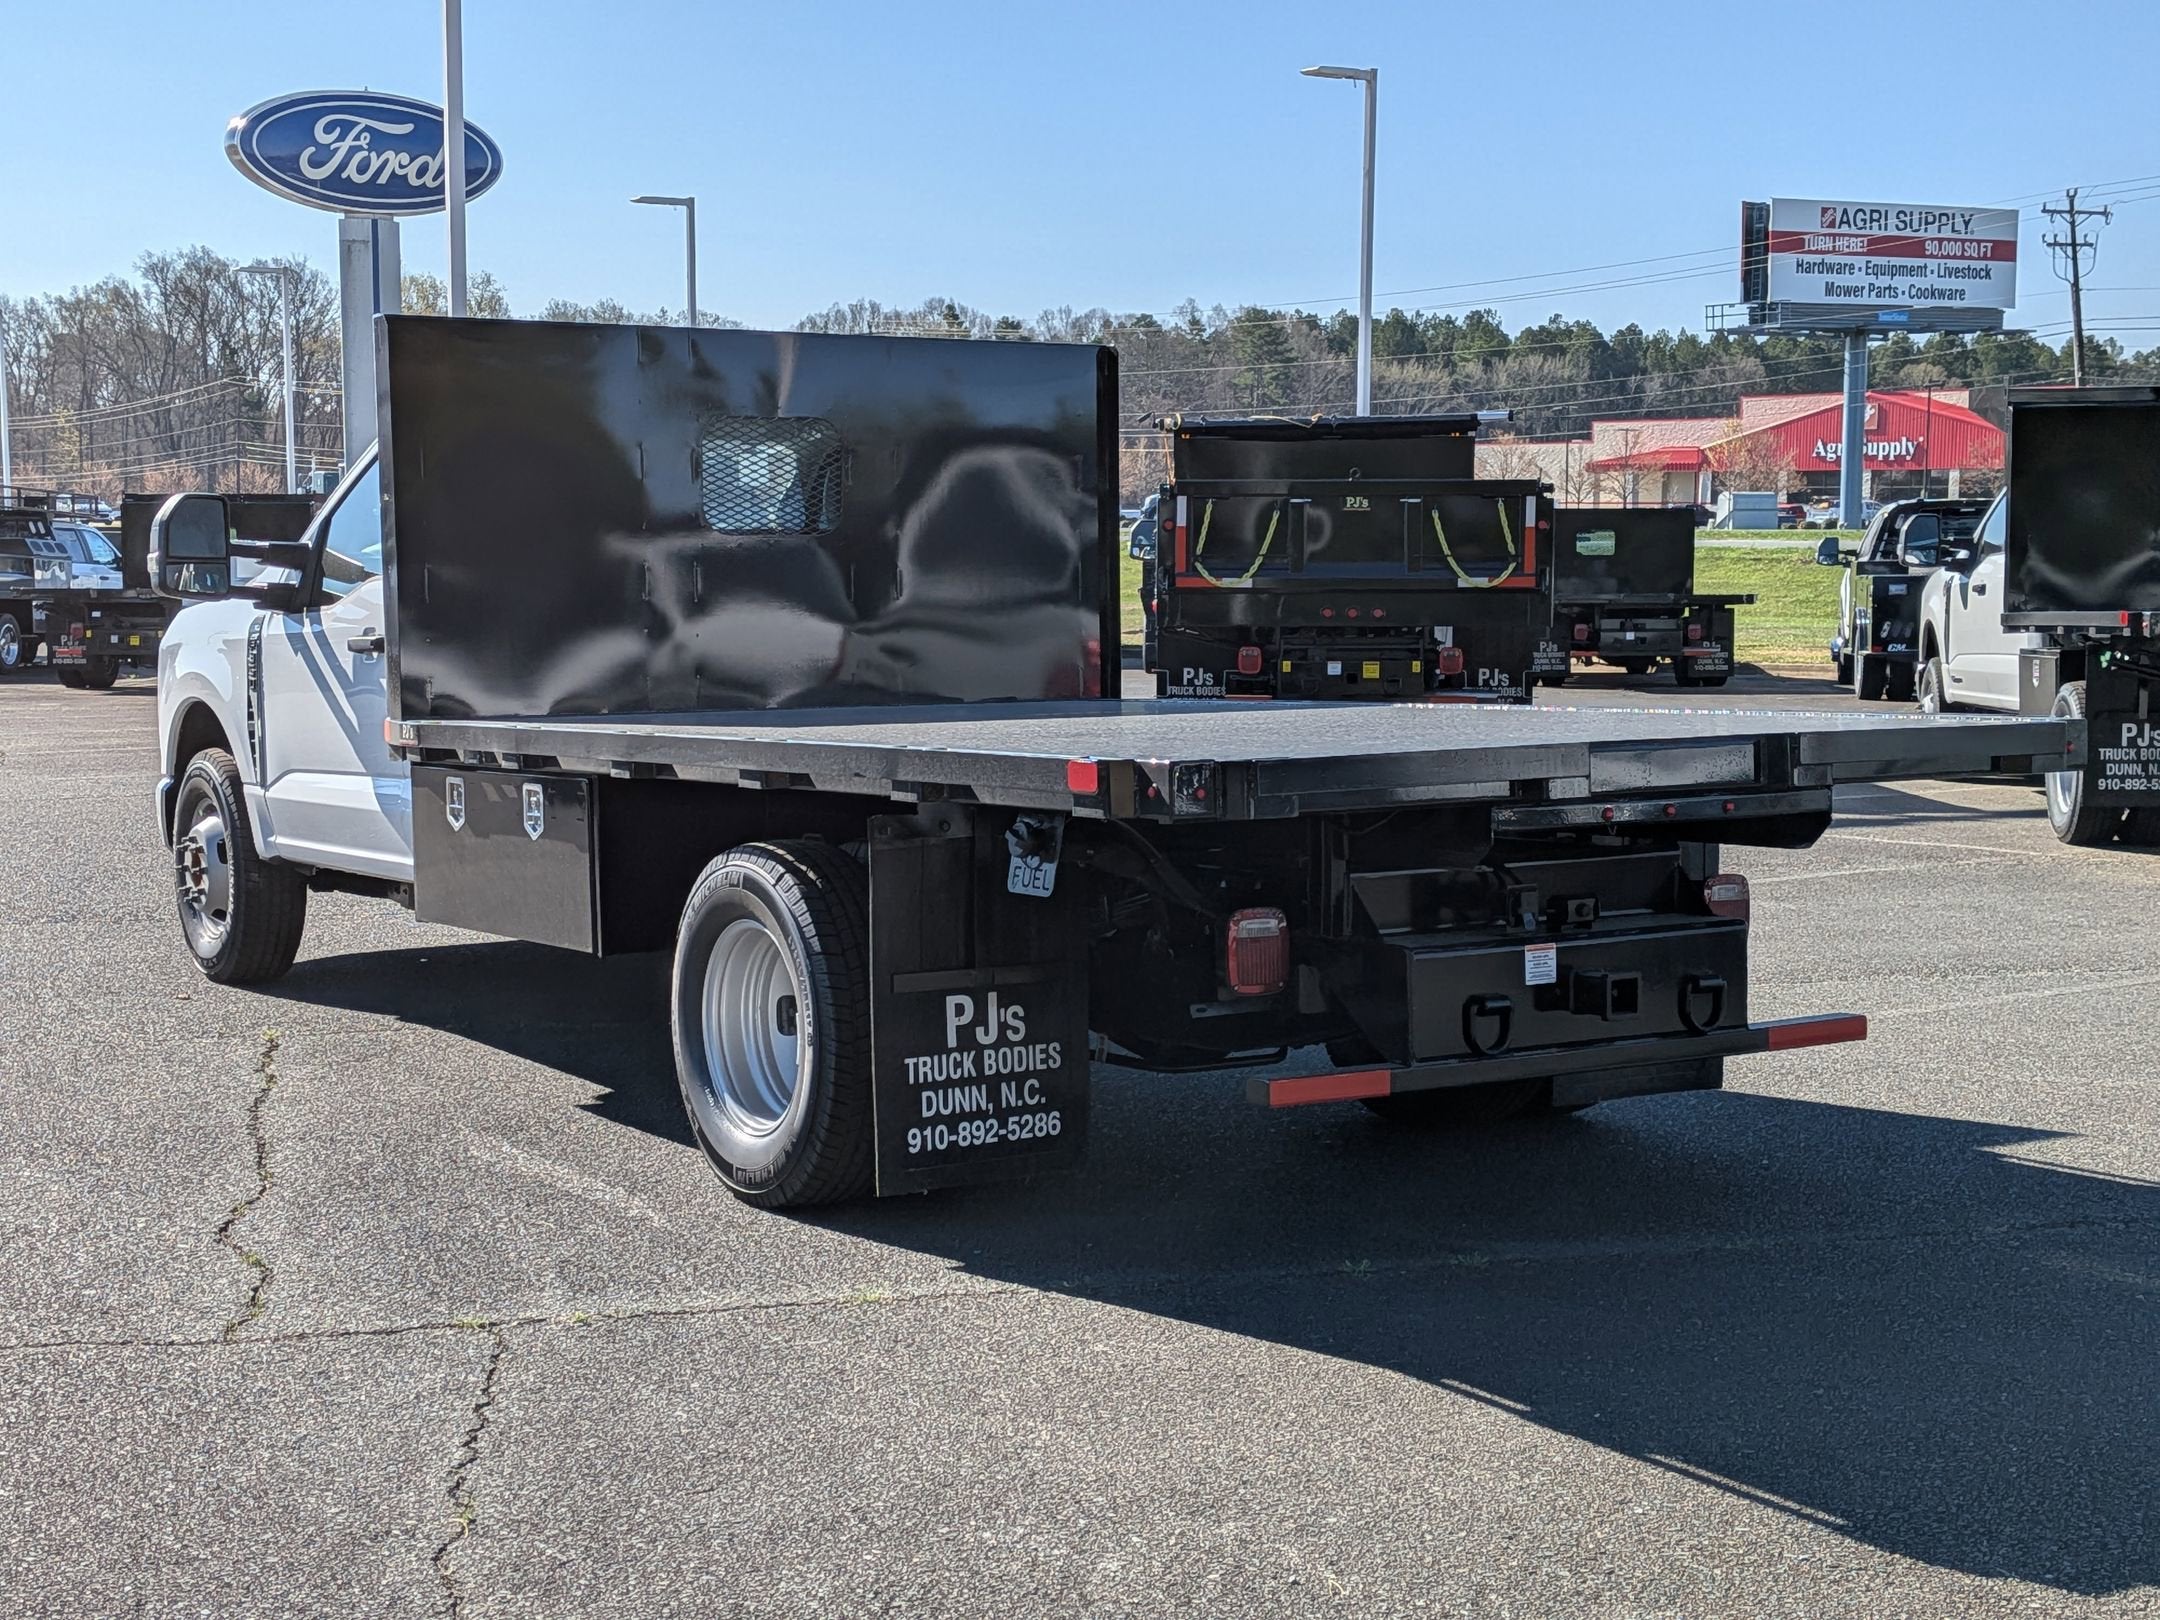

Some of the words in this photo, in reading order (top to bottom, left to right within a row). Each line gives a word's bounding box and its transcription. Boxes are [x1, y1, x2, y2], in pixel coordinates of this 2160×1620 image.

[299, 113, 445, 189] Ford
[1838, 208, 1889, 231] AGRI
[1894, 210, 1974, 235] SUPPLY
[1803, 235, 1835, 251] TURN
[1836, 236, 1868, 252] HERE!
[1925, 240, 1962, 258] 90,000
[1964, 241, 1978, 258] SQ
[1980, 242, 1993, 258] FT
[1796, 257, 1855, 275] Hardware
[1865, 260, 1928, 281] Equipment
[1937, 262, 1992, 280] Livestock
[1825, 281, 1866, 298] Mower
[1868, 282, 1899, 299] Parts
[1908, 284, 1966, 301] Cookware
[1812, 439, 1842, 461] Agr
[1346, 496, 1369, 508] PJ's
[1183, 667, 1213, 685] PJ's
[1478, 668, 1509, 686] PJ's
[1169, 686, 1195, 695] TRUCK
[1196, 686, 1226, 696] BODIES
[2098, 748, 2137, 760] TRUCK
[2106, 763, 2145, 777] DUNN,
[2098, 778, 2160, 790] 910-892-5
[1011, 865, 1049, 891] FUEL
[945, 992, 1026, 1048] PJ's
[904, 1050, 977, 1085] TRUCK
[984, 1041, 1062, 1076] BODIES
[921, 1084, 994, 1118] DUNN,
[1001, 1078, 1047, 1109] N.C.
[907, 1111, 1062, 1154] 910-892-5286
